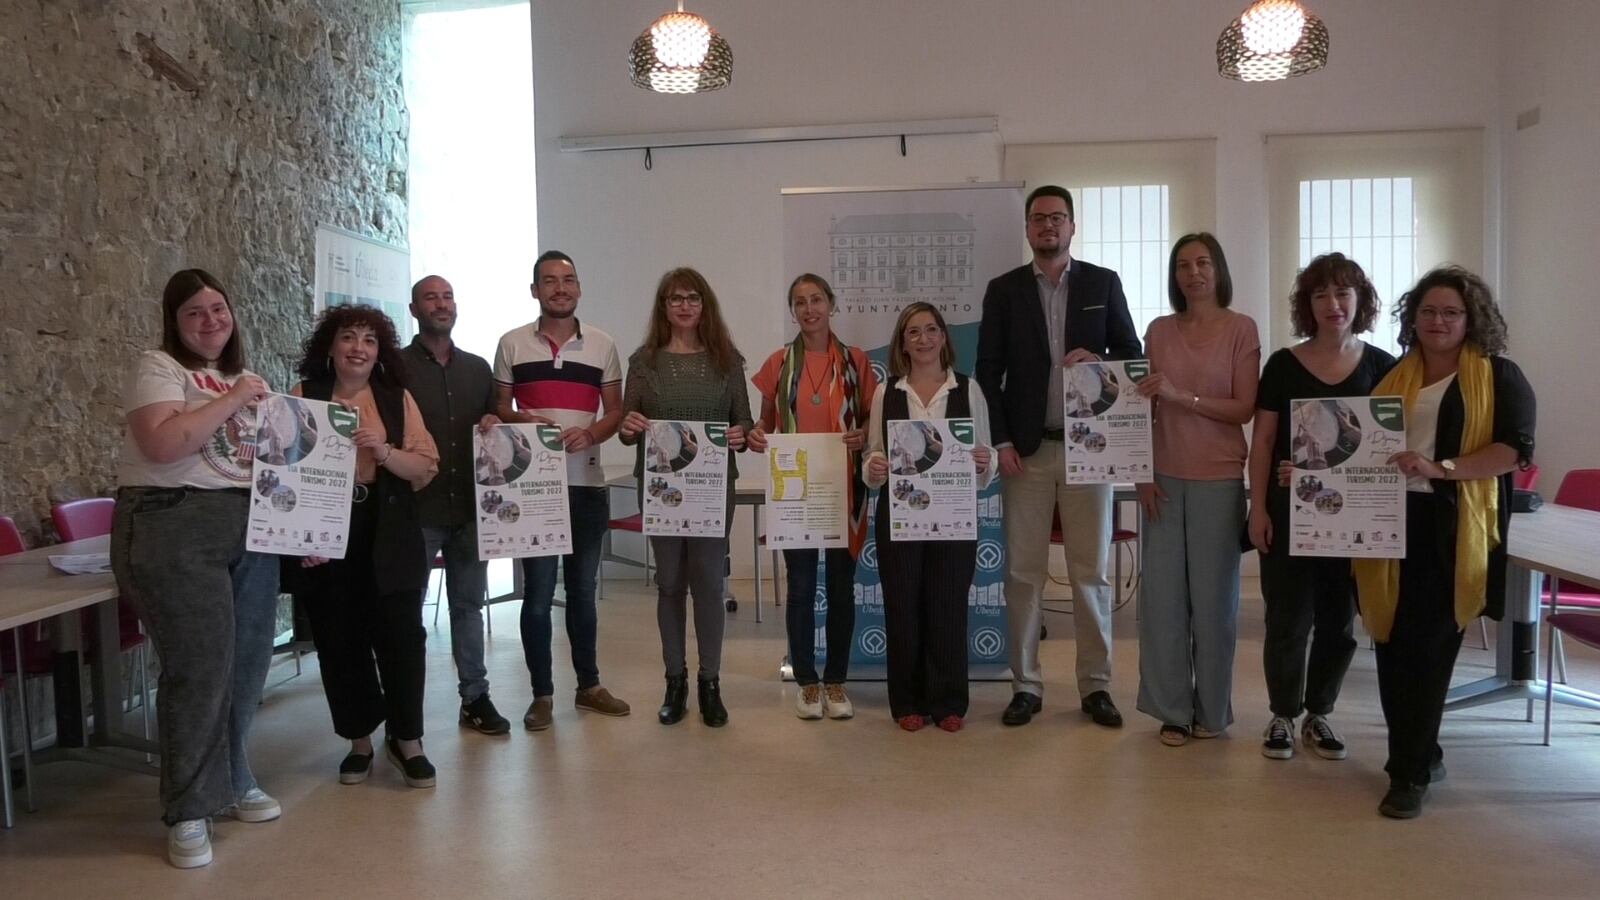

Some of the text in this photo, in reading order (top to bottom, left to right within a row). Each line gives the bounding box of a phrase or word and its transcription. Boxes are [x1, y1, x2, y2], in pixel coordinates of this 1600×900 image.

[834, 303, 972, 314] AYUNTANTO
[300, 467, 347, 479] INTERNACIONAL
[1345, 466, 1399, 474] INTERNACIONAL
[300, 475, 347, 488] TURISMO 2022
[956, 478, 972, 486] 2022
[1346, 475, 1399, 483] TURISMO 2022
[520, 480, 562, 488] INTERNACIONAL
[521, 487, 562, 496] TURISMO 2022
